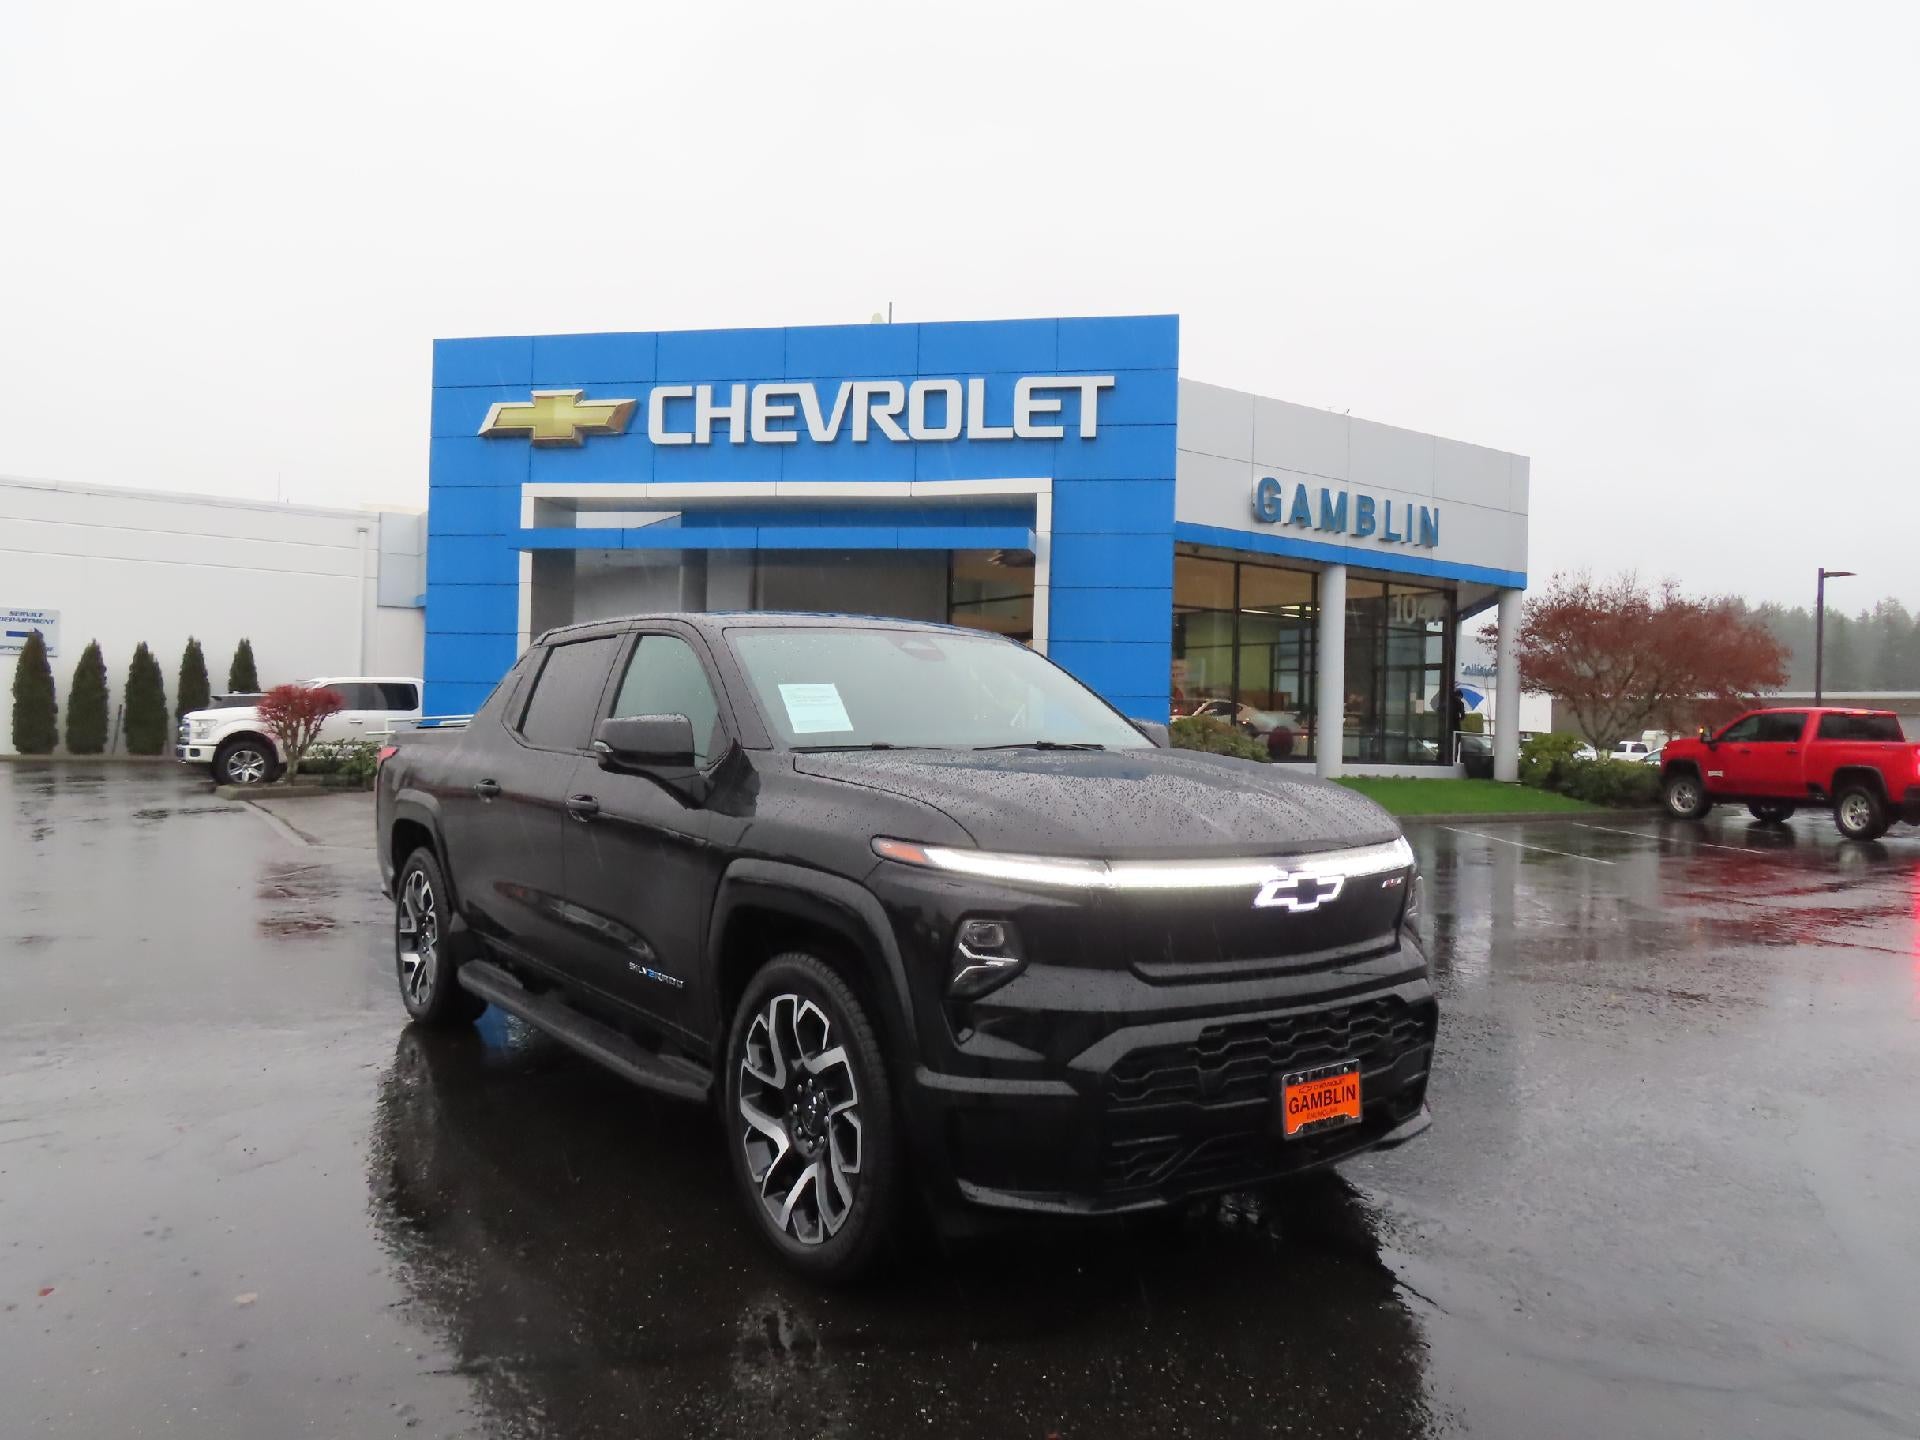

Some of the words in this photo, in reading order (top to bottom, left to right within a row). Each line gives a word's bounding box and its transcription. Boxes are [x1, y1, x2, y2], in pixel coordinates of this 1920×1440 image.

[648, 375, 1115, 445] CHEVROLET
[1254, 476, 1440, 547] GAMBLIN
[629, 961, 684, 989] SILVERADO
[1289, 1084, 1356, 1115] GAMBLIN
